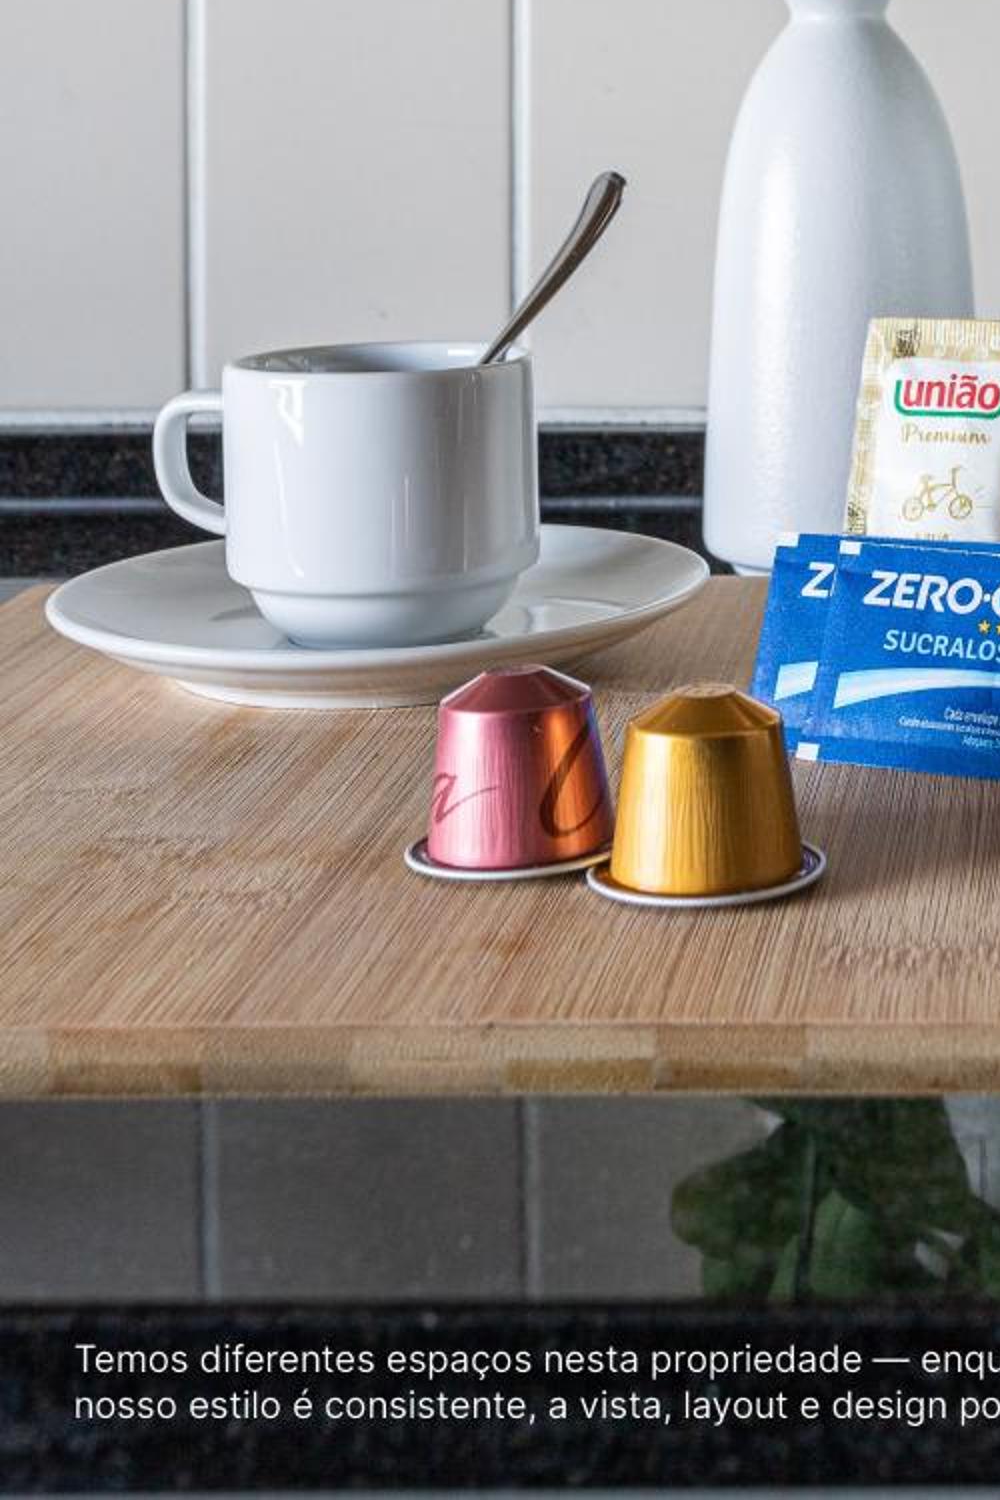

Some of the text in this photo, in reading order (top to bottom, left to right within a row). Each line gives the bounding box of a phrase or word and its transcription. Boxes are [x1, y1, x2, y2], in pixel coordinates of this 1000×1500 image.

[902, 373, 1000, 411] união
[902, 422, 991, 445] Premium
[801, 561, 838, 598] Z
